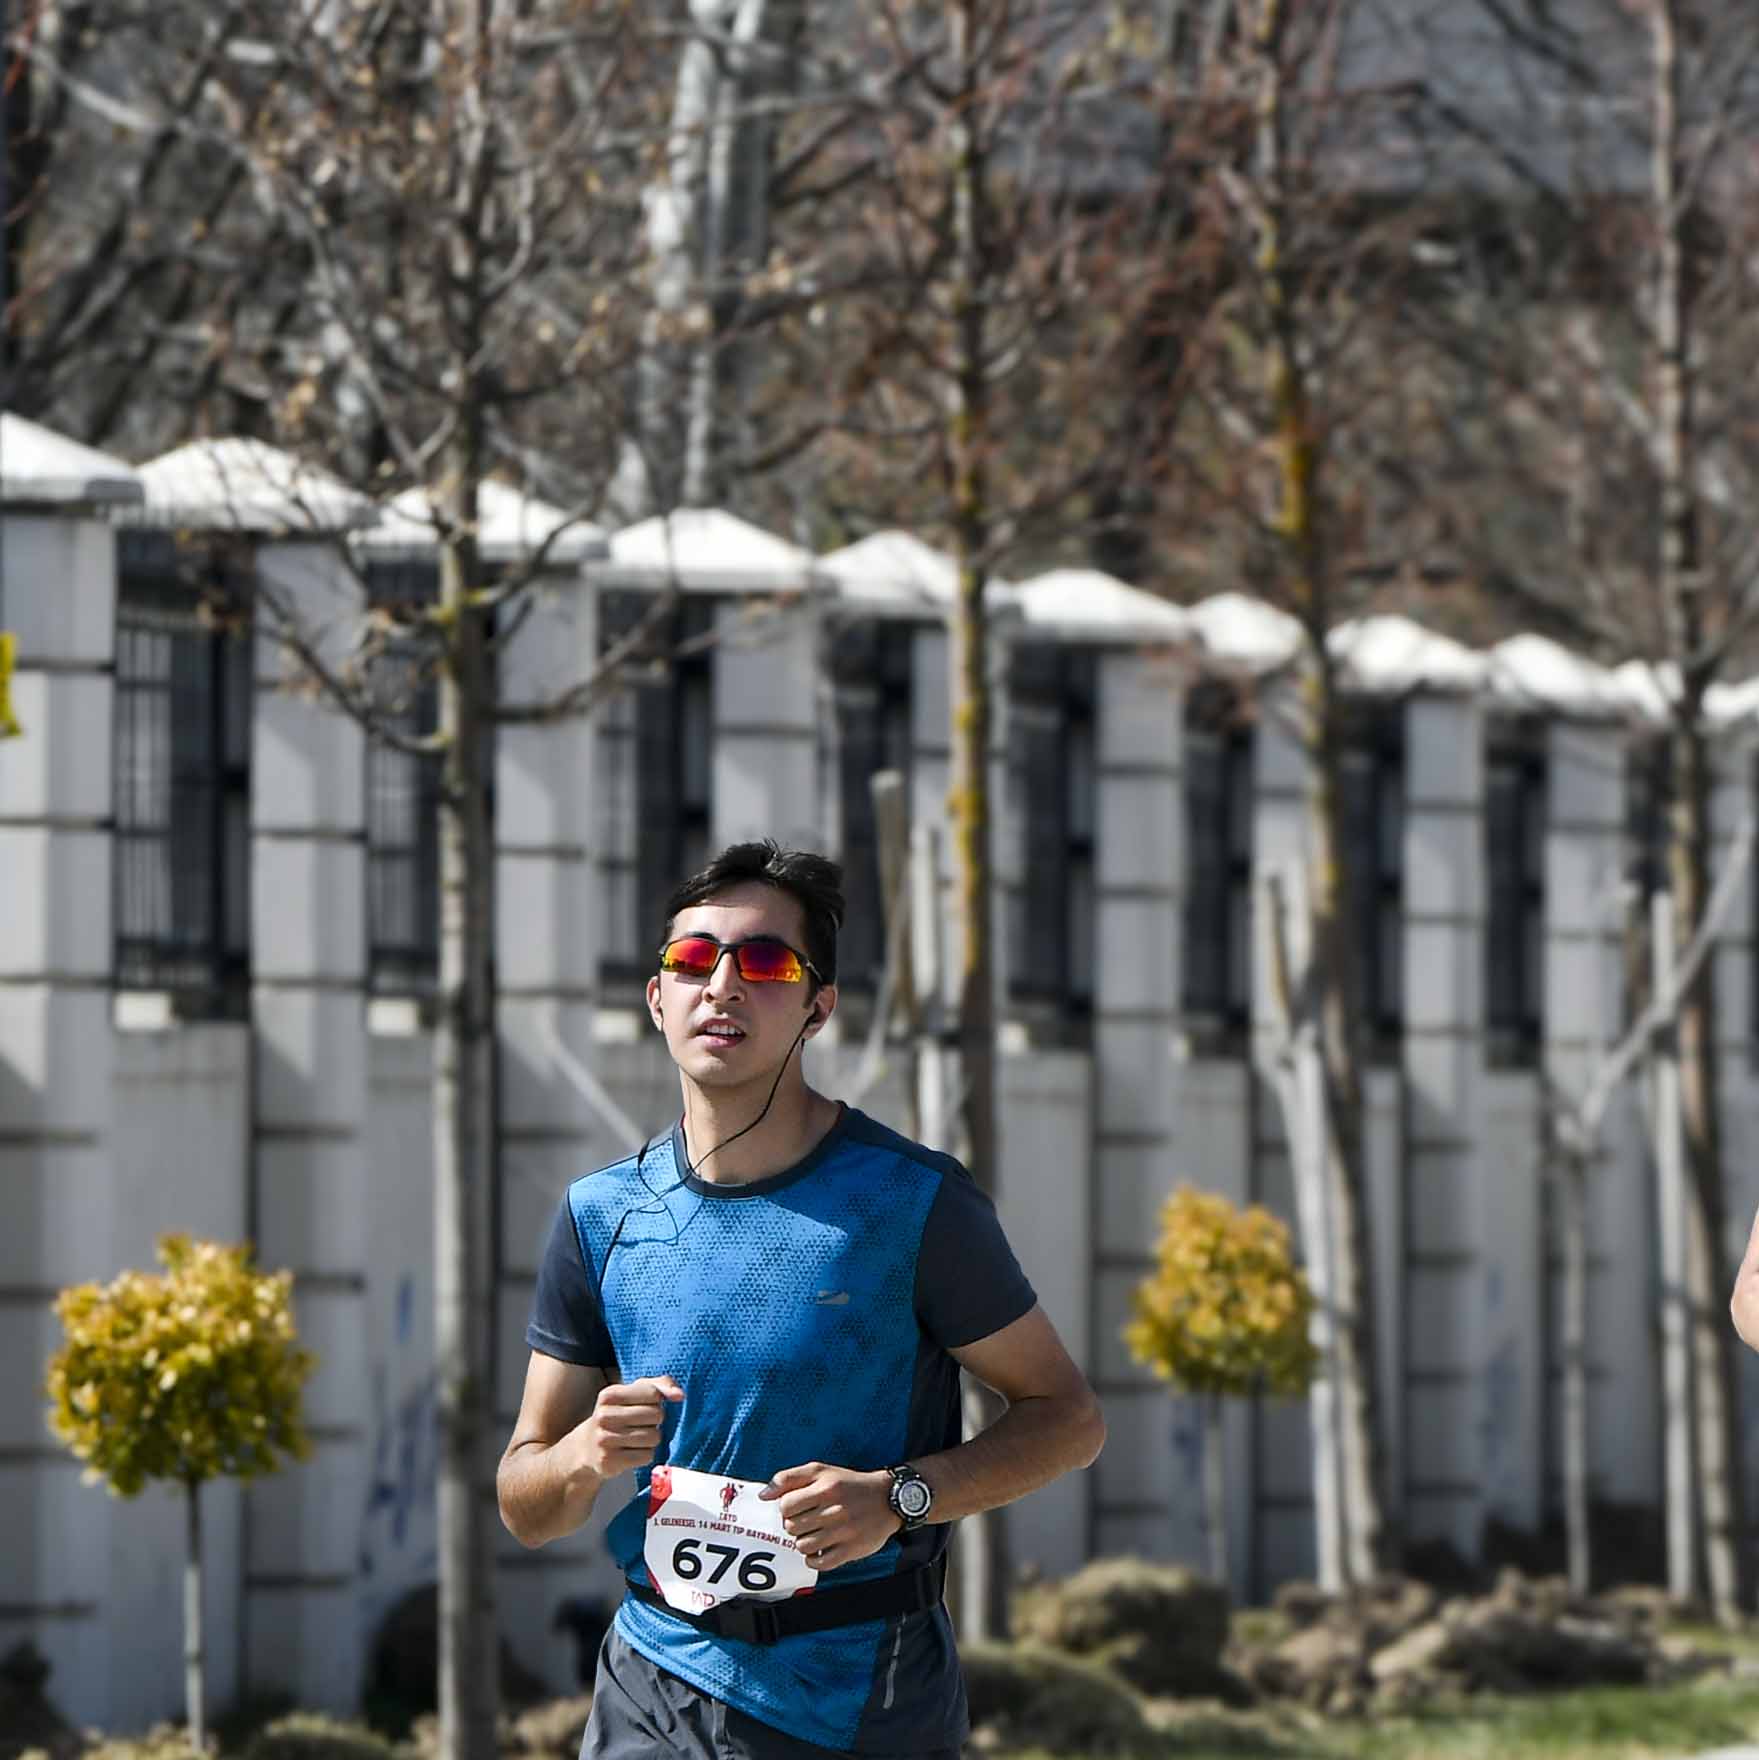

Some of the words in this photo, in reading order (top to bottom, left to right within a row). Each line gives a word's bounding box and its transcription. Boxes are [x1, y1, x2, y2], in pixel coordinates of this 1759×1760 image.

[710, 1522, 731, 1533] MART
[733, 1524, 745, 1535] TIP
[673, 1538, 777, 1591] 676
